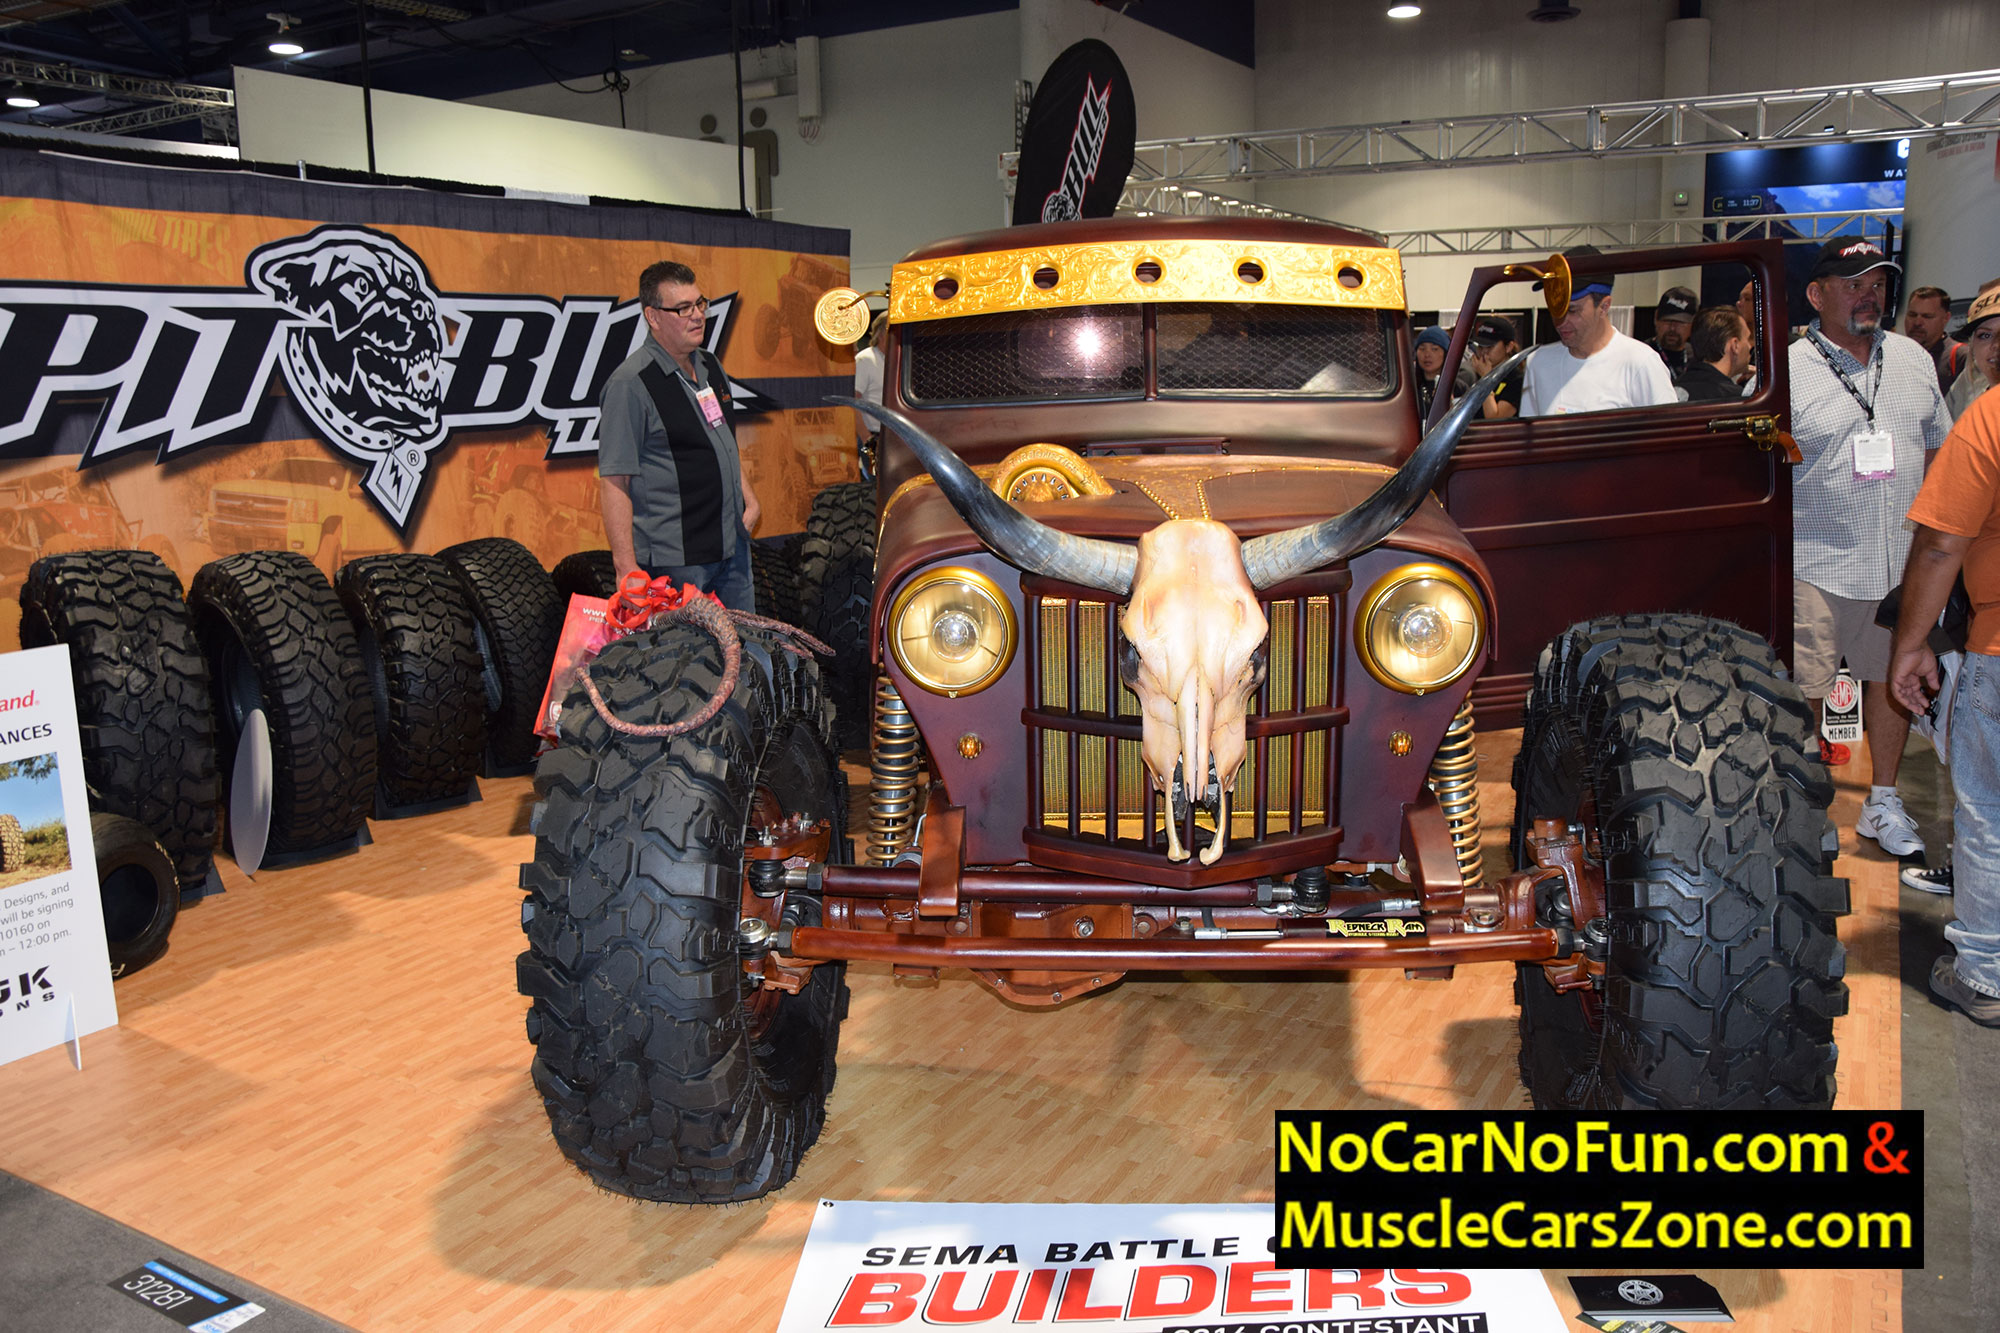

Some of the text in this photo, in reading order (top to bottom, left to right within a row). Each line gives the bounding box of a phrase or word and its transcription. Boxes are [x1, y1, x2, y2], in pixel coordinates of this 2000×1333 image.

[1060, 79, 1109, 213] BULL
[163, 215, 234, 284] TIRES
[0, 303, 308, 434] PIT
[1829, 726, 1857, 739] MEMBER
[4, 882, 70, 909] Designs, and
[0, 898, 74, 925] will be signing
[37, 920, 50, 930] on
[20, 933, 50, 950] 12:00
[53, 929, 72, 942] pm.
[862, 1244, 1019, 1267] SEMA
[1045, 1236, 1240, 1262] BATTLE
[123, 1274, 194, 1310] 31281
[825, 1261, 1473, 1328] BUILDERS
